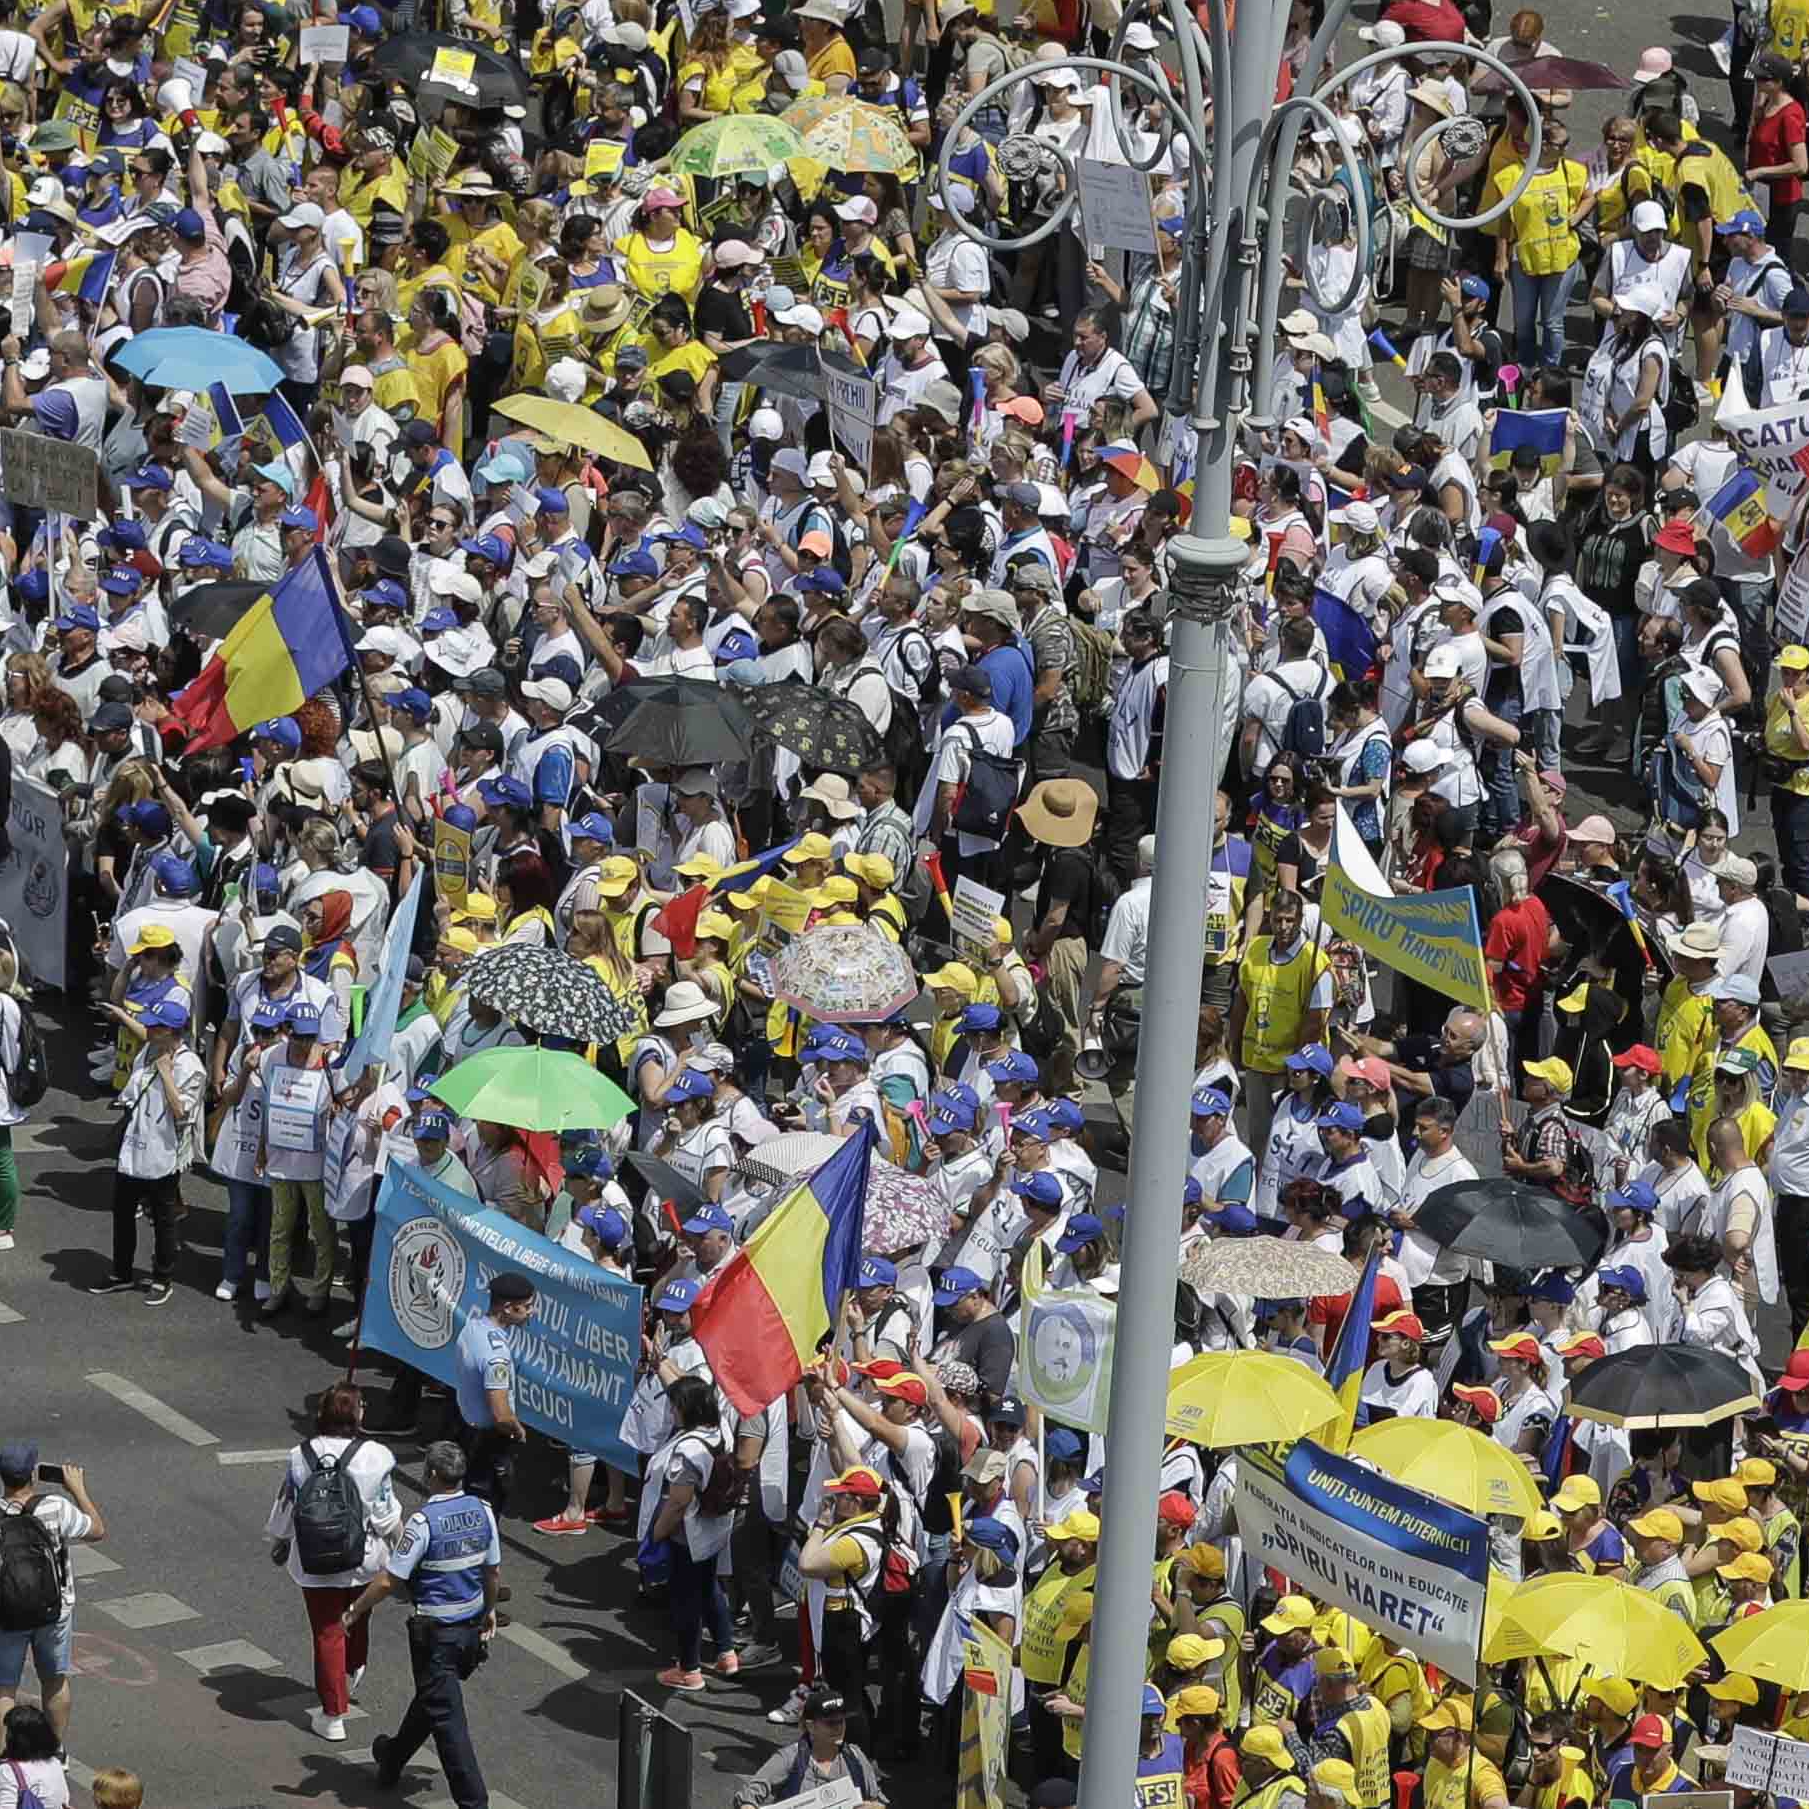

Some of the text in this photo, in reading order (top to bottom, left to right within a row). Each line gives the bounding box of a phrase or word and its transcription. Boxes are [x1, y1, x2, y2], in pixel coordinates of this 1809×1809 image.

[573, 1314, 631, 1365] LIBER
[512, 1374, 574, 1428] ECUCI
[440, 1509, 484, 1533] DIALOG
[1308, 1469, 1469, 1555] UNIȚI SUNTEM PUTERNICI!
[1261, 1522, 1446, 1636] „SPIRU HARET“
[1299, 1516, 1375, 1574] SINDICATELOR
[1379, 1565, 1404, 1585] DIN
